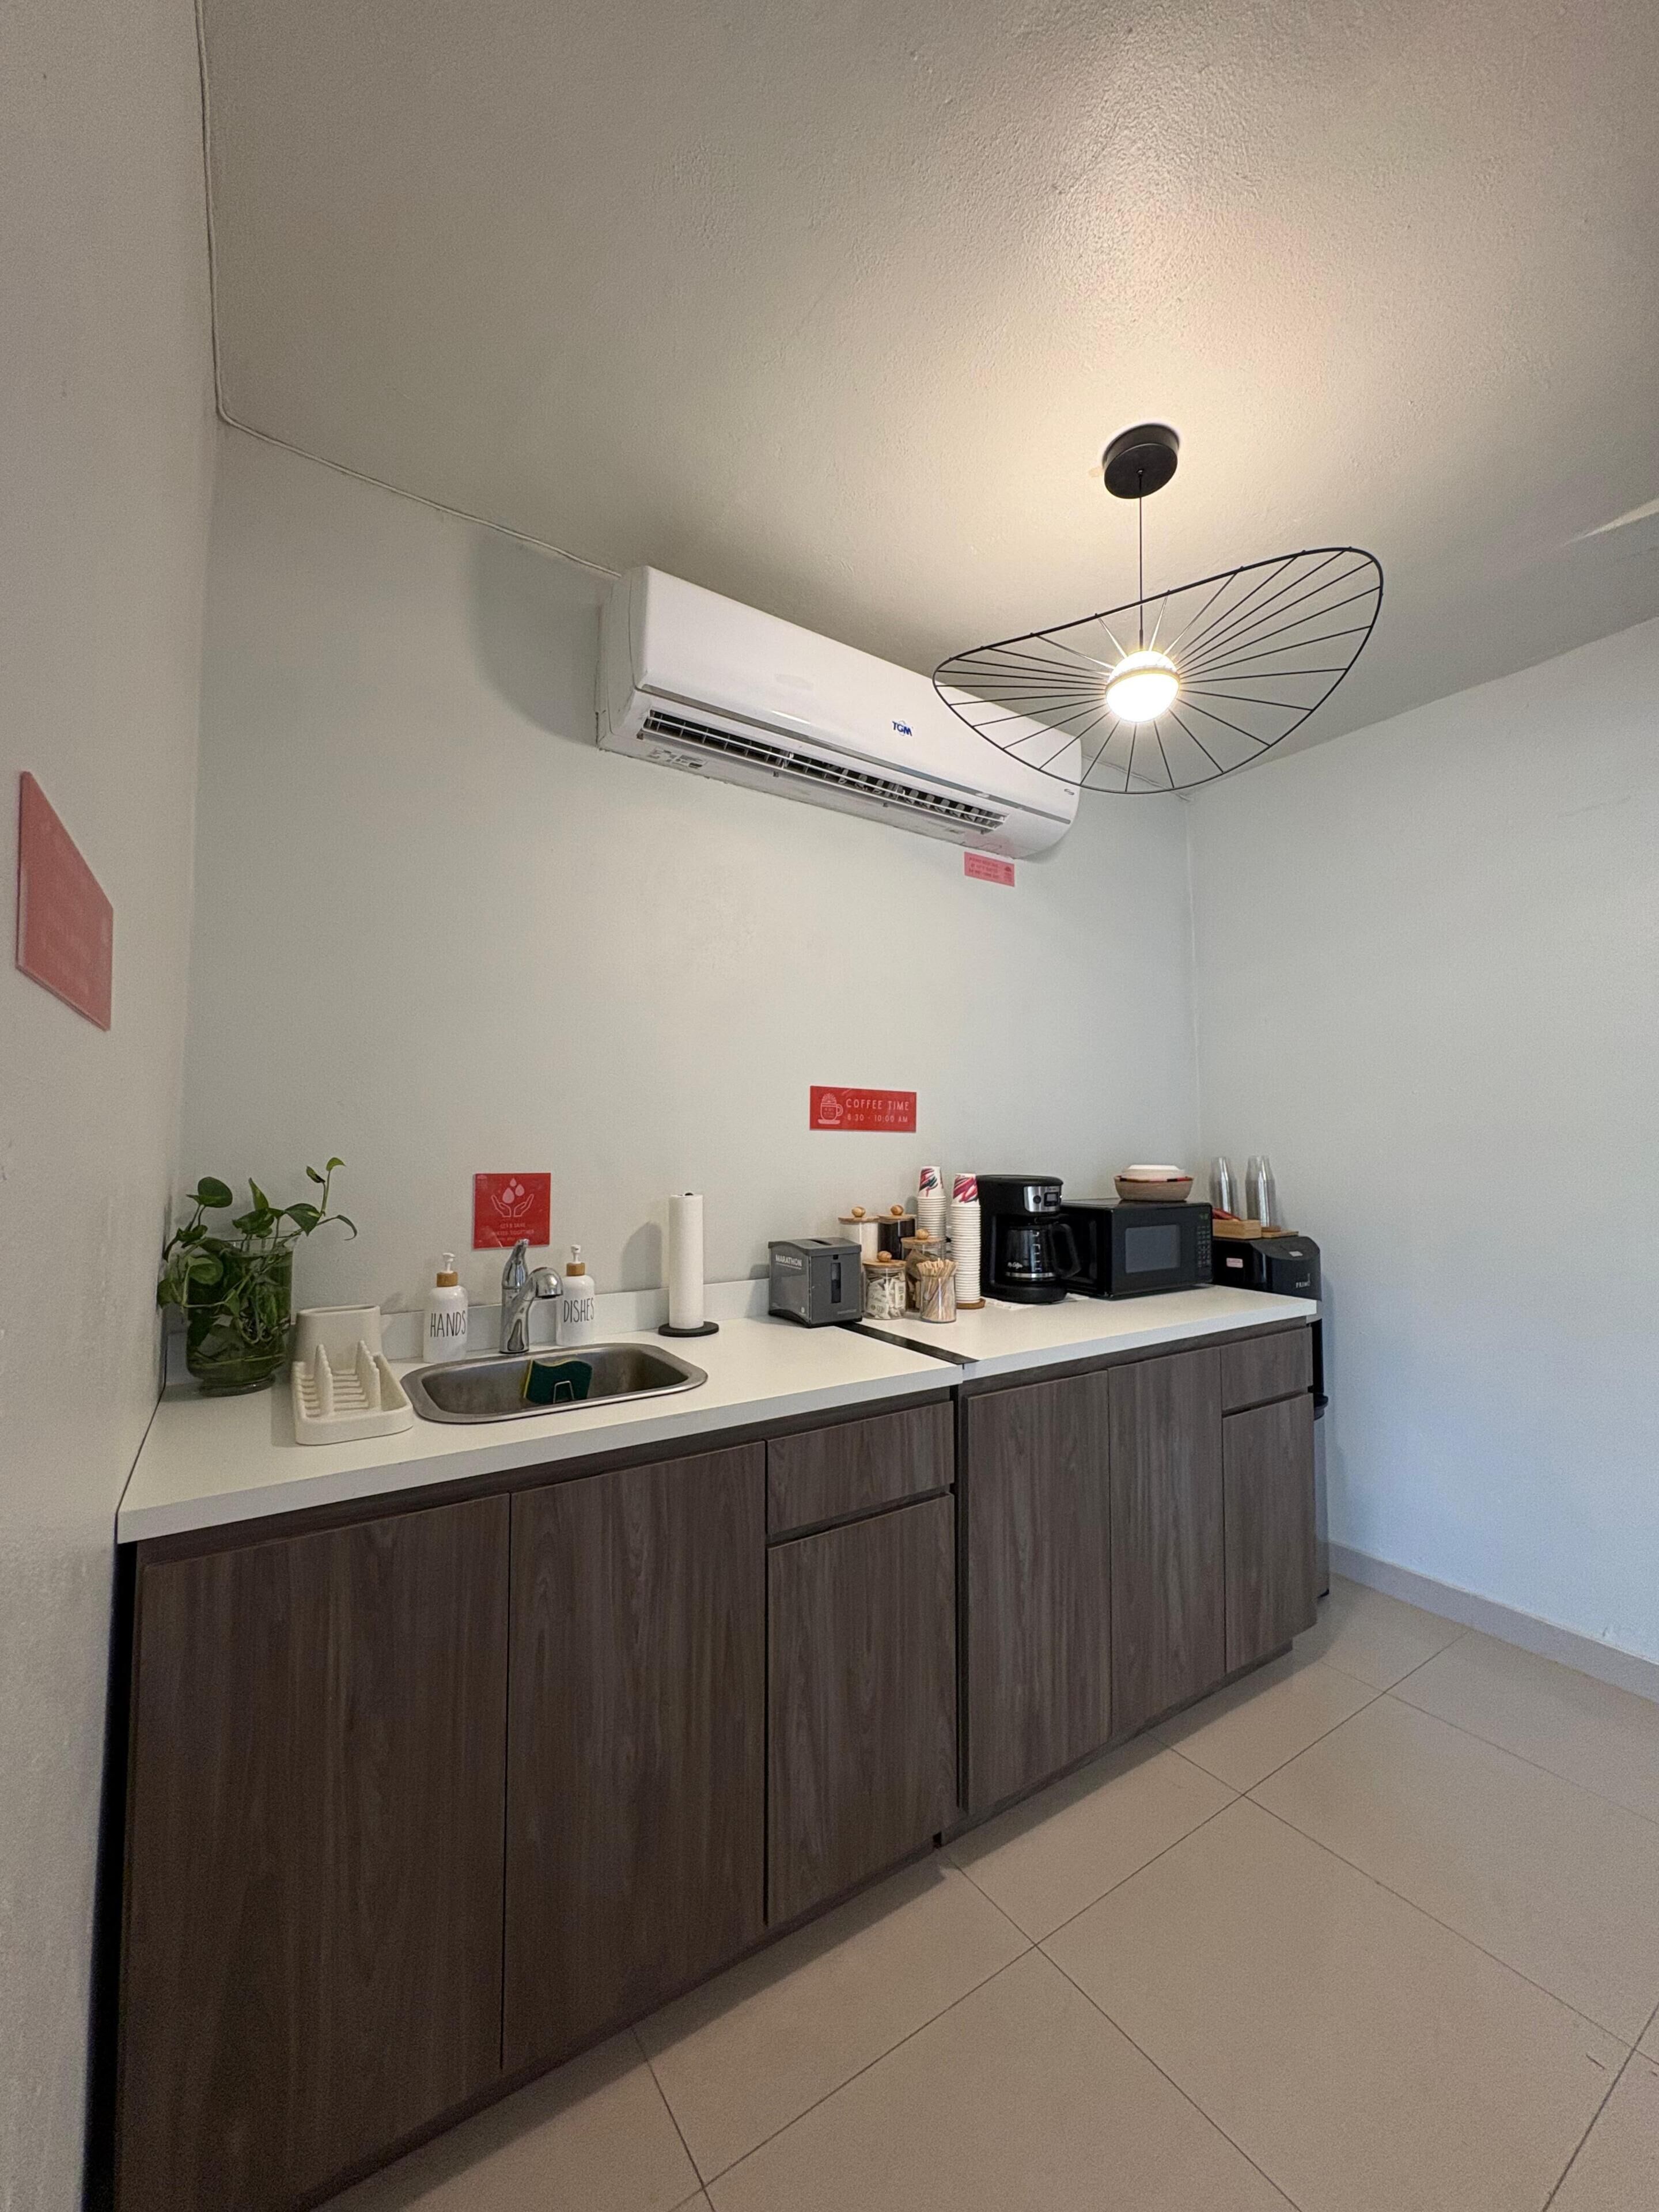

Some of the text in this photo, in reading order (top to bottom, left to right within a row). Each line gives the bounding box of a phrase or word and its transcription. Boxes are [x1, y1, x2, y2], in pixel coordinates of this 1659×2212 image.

[892, 721, 912, 736] TGM
[846, 1099, 909, 1111] COFFEE TIME
[874, 1115, 895, 1123] 10:00
[775, 1254, 802, 1267] MARATHON
[563, 1297, 594, 1323] DISHES
[430, 1310, 466, 1337] HANDS
